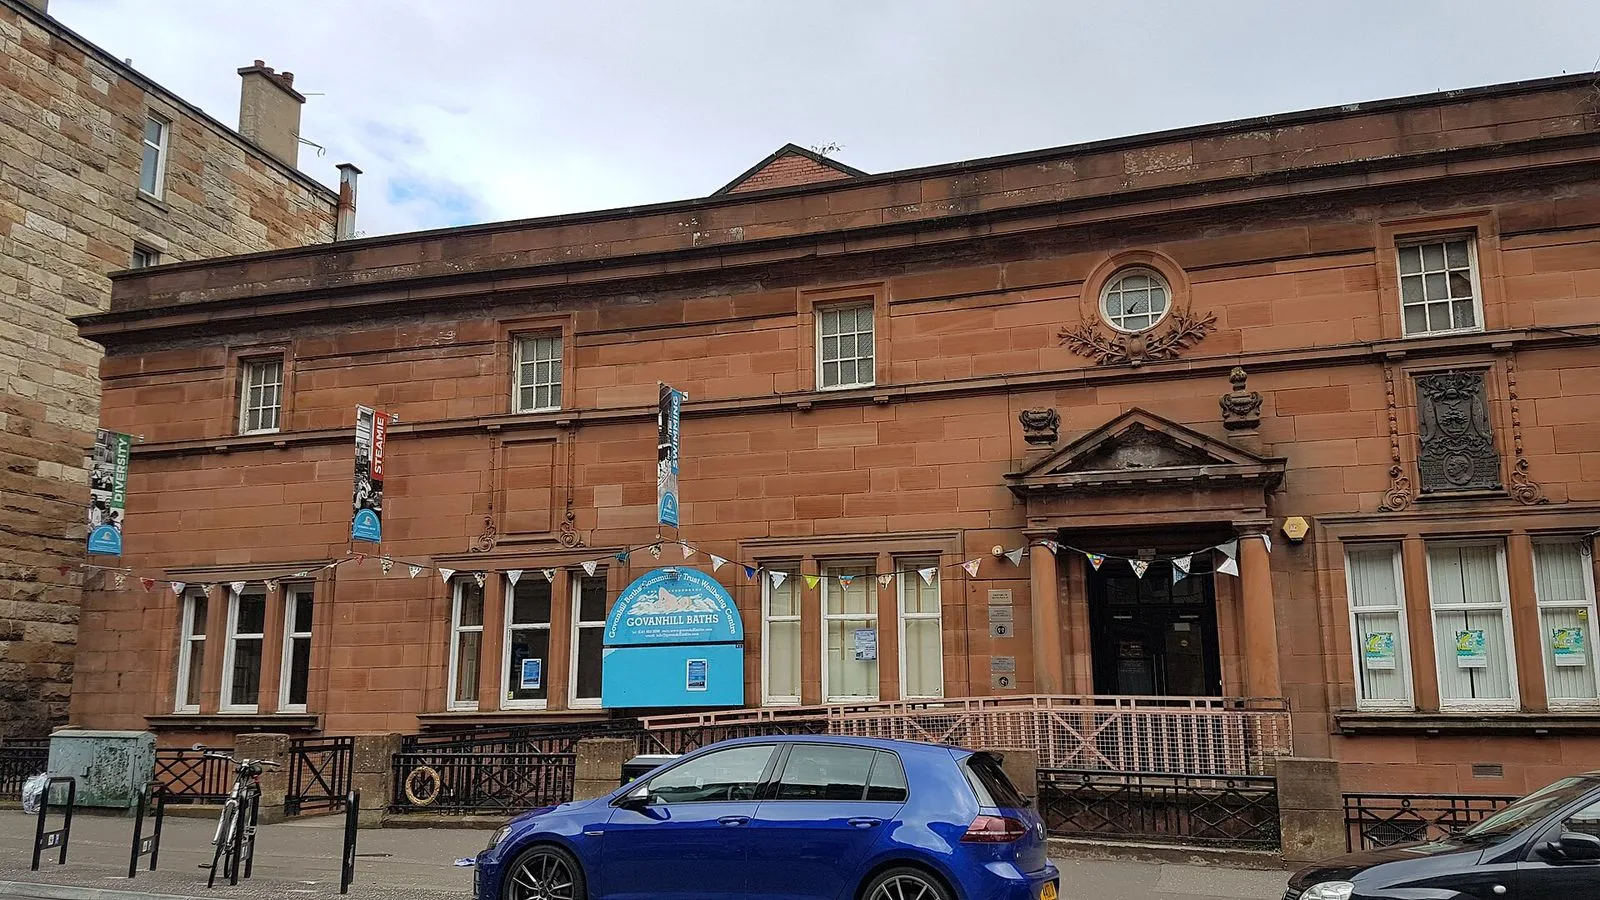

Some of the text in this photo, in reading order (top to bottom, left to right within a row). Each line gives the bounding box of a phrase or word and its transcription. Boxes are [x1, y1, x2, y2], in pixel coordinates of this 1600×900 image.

[114, 438, 128, 502] DIVERSITY
[374, 416, 385, 474] STEAMIE
[608, 573, 736, 638] Govanhill Baths Communy Trust Wellbeing Centre
[626, 614, 719, 627] GOVANHILL BATHS
